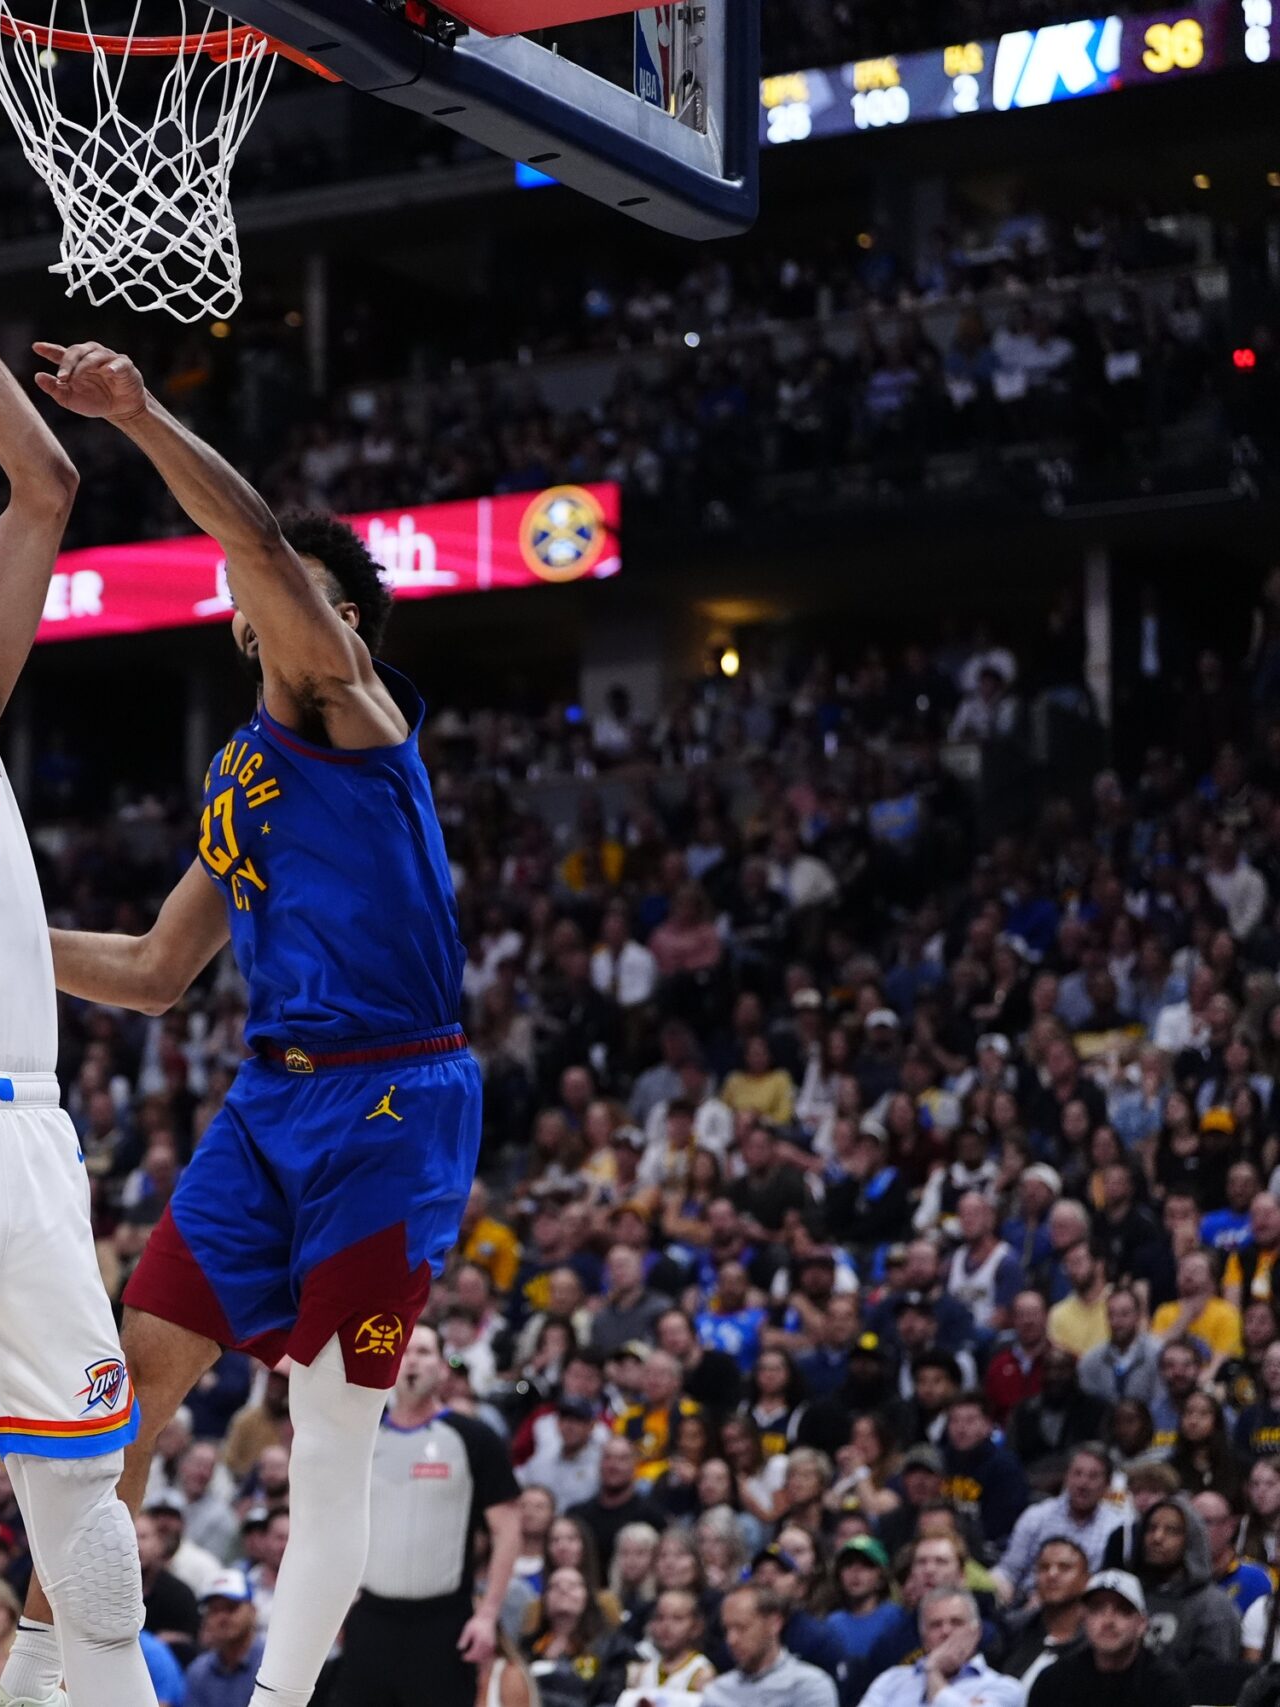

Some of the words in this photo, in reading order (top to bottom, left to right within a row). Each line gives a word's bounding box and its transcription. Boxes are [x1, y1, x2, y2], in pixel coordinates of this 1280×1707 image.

[1142, 18, 1204, 74] 36
[640, 67, 657, 101] NBA
[851, 86, 910, 129] 100
[953, 74, 980, 113] 2
[220, 740, 281, 809] HIGH
[199, 786, 239, 876] 27
[231, 857, 267, 912] CY
[88, 1366, 120, 1404] OKC
